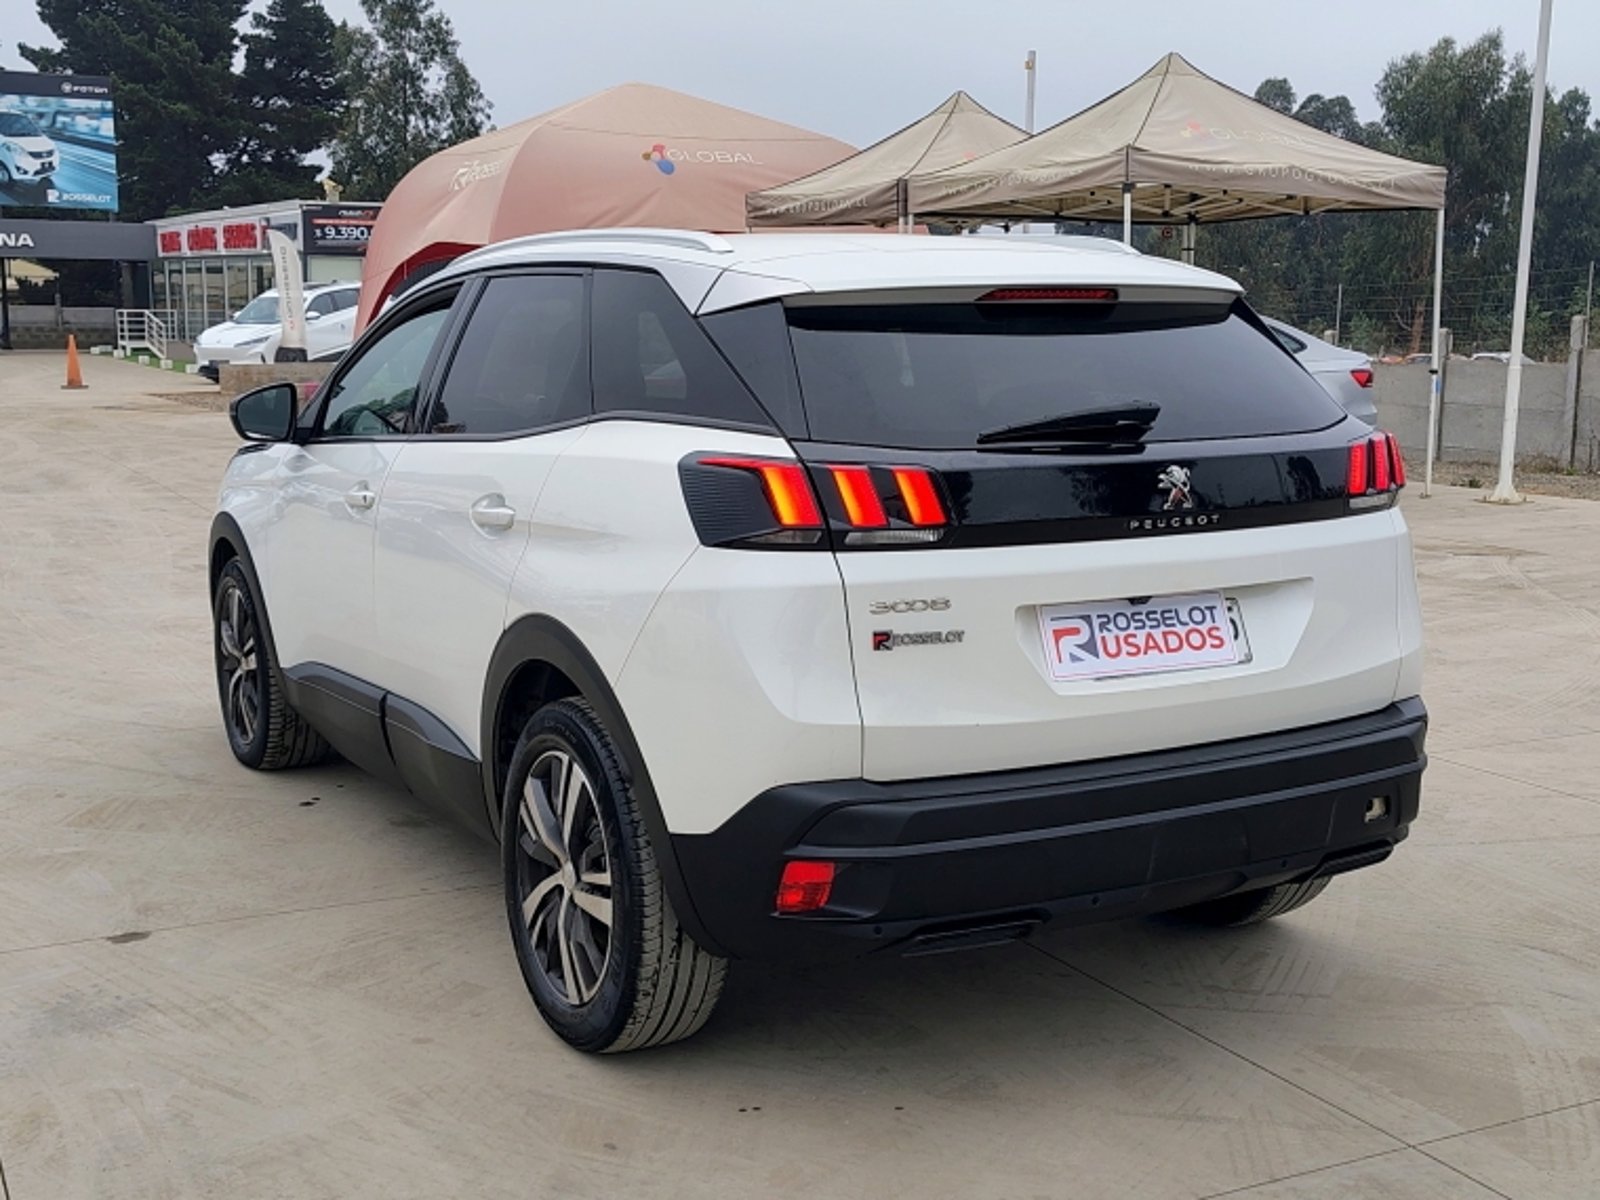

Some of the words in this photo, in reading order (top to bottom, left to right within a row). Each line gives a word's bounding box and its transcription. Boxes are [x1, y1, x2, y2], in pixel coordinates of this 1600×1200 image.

[667, 149, 764, 165] GLOBAL
[62, 193, 112, 203] ROSSELOT
[1129, 514, 1220, 530] PEUGEOT
[869, 597, 952, 615] 3008
[1097, 606, 1218, 633] ROSSELOT
[892, 631, 965, 647] ROSSELOT
[1101, 625, 1226, 659] USADOS
